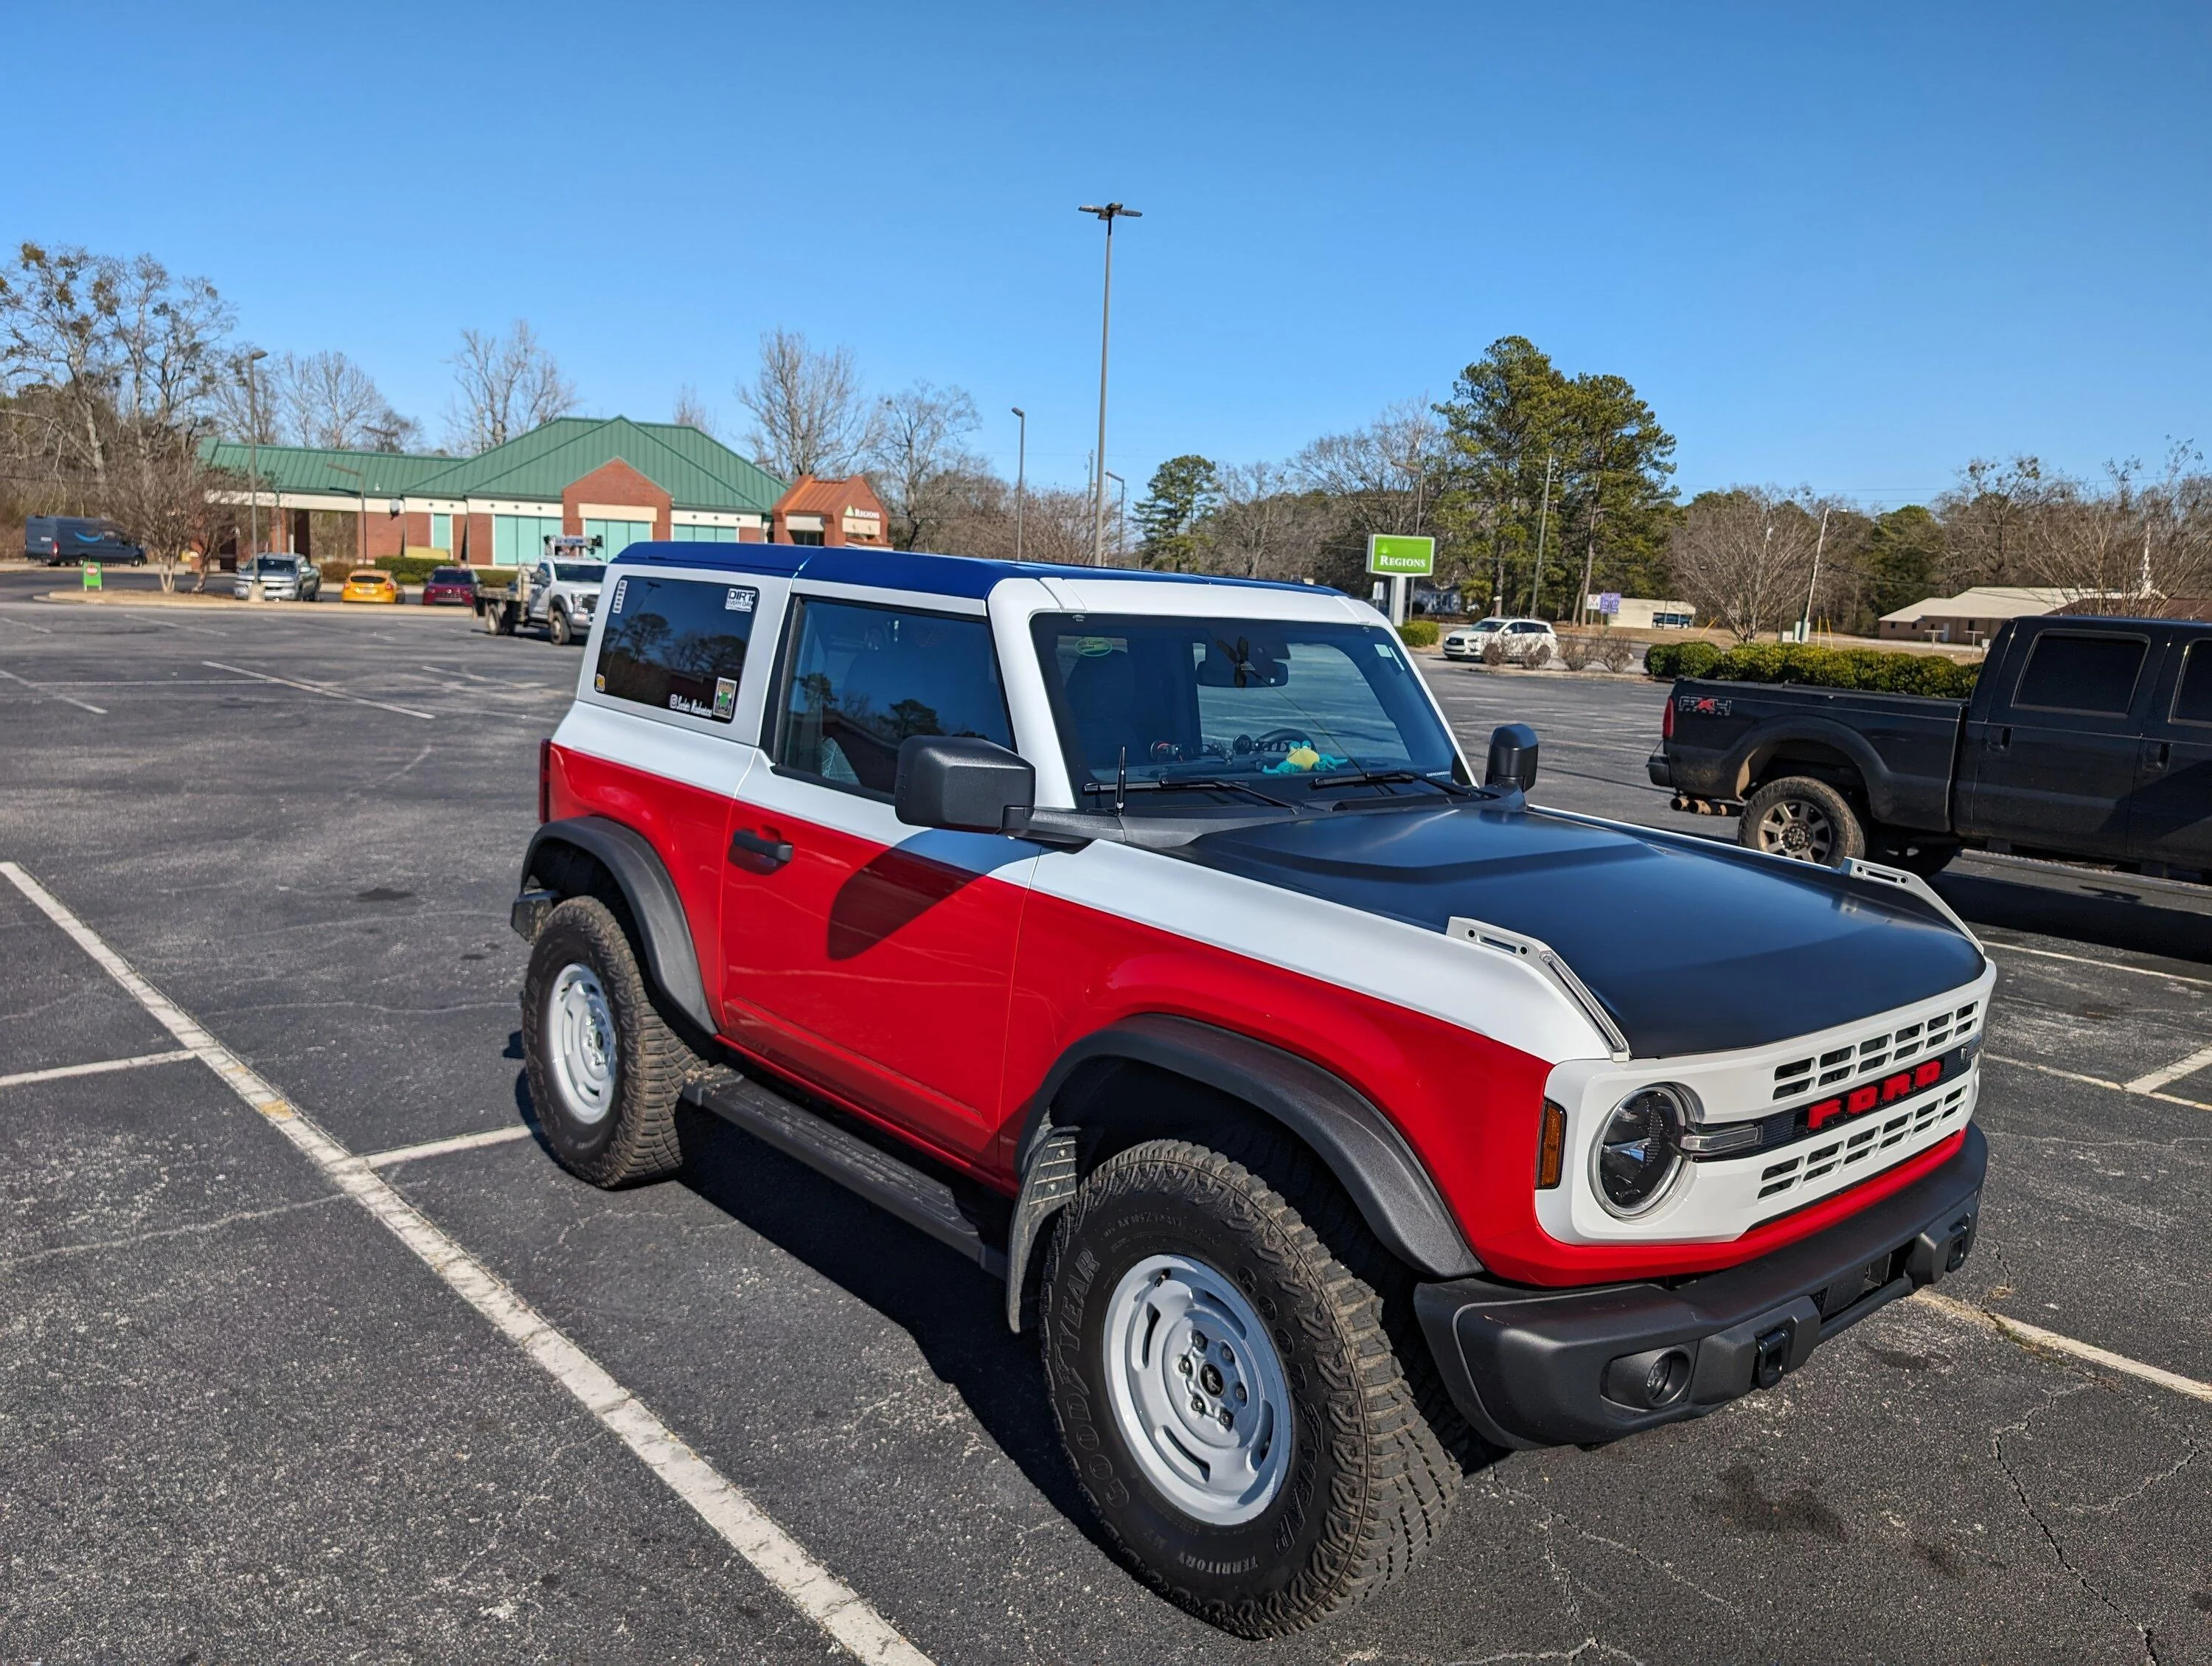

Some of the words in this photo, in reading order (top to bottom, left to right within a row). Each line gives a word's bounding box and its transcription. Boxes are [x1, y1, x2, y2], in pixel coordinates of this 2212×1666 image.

[1380, 555, 1426, 567] REGIONS
[729, 590, 755, 601] DIRT
[1808, 1061, 1941, 1130] FORD
[1178, 1551, 1258, 1575] TERRITORY
